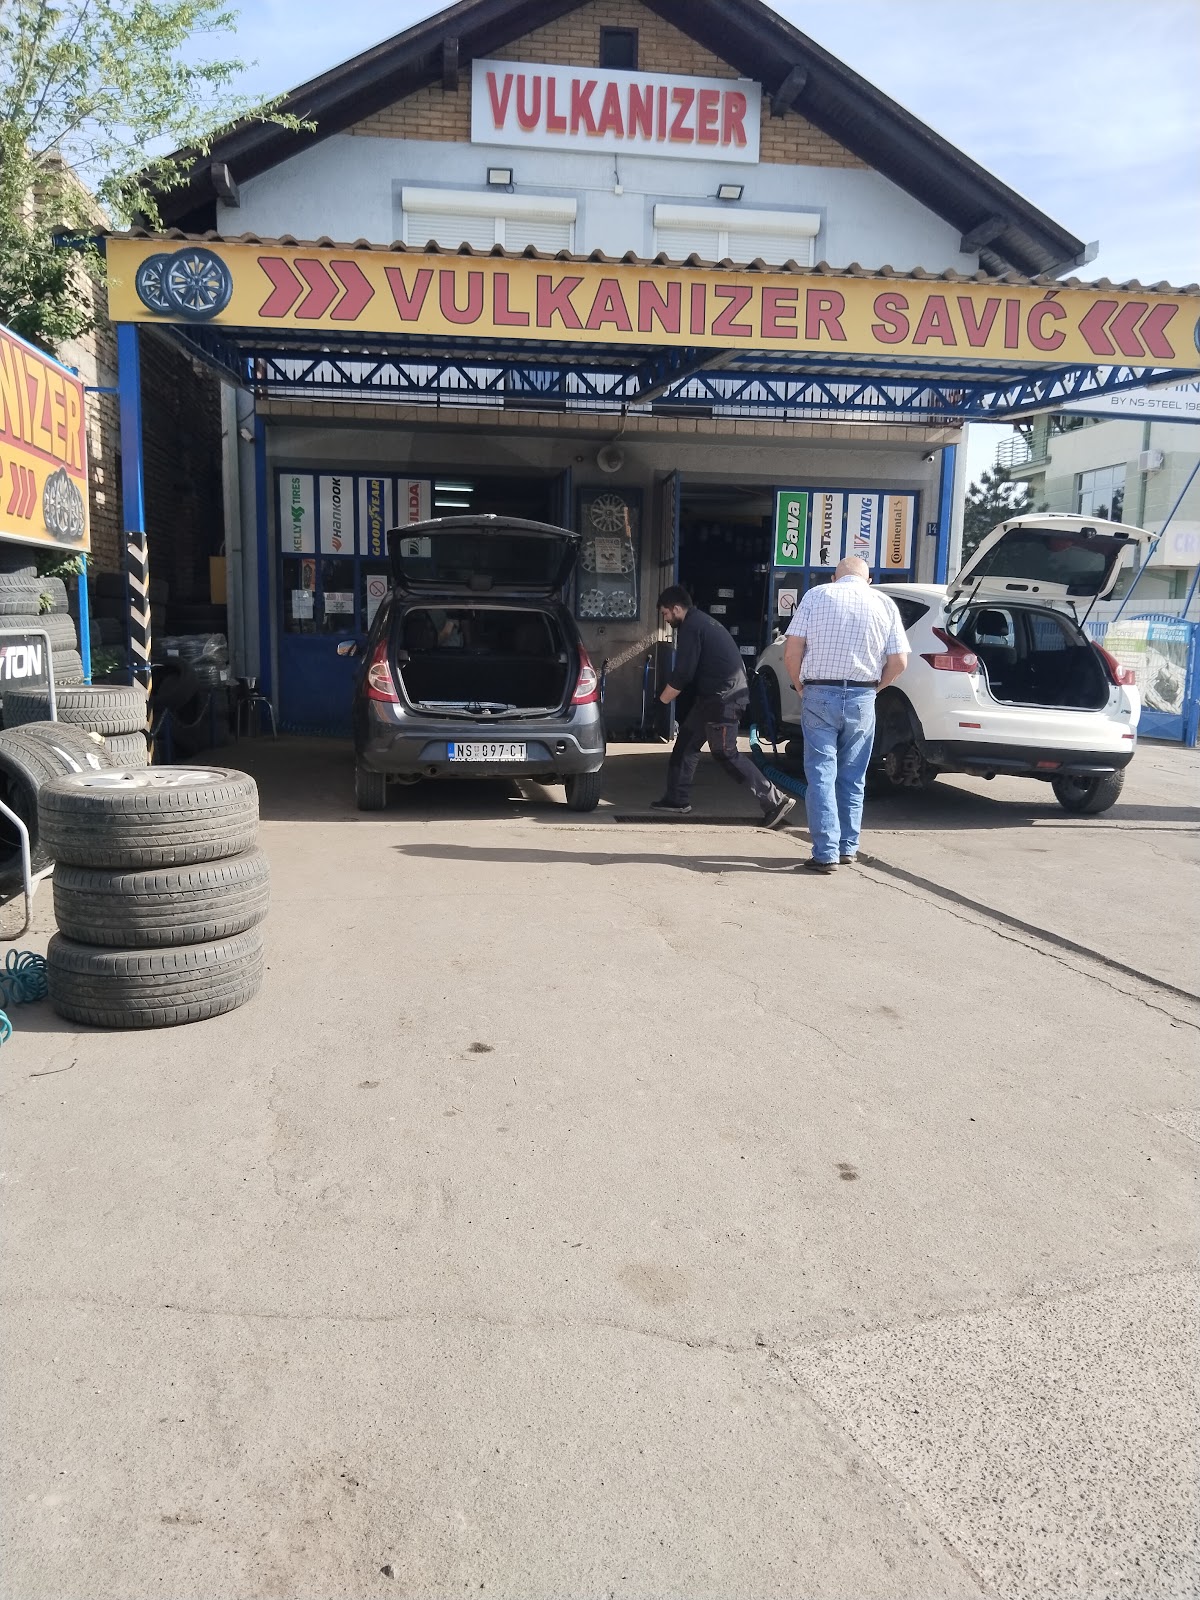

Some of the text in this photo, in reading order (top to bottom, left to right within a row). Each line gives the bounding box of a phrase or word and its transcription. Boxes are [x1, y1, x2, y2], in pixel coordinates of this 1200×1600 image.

[486, 71, 747, 146] VULKANIZER
[384, 267, 1067, 351] VULKANIZER SAVIĆ
[1111, 397, 1127, 405] BY
[1129, 398, 1182, 410] NS-STEEL
[291, 477, 302, 552] KELLY TIRES
[371, 480, 381, 556] GOODYEAR
[782, 501, 801, 560] Sava
[821, 494, 833, 548] TAURUS
[853, 497, 872, 549] VIKING
[891, 508, 902, 564] Continental
[928, 524, 938, 534] 14
[457, 744, 472, 757] NS
